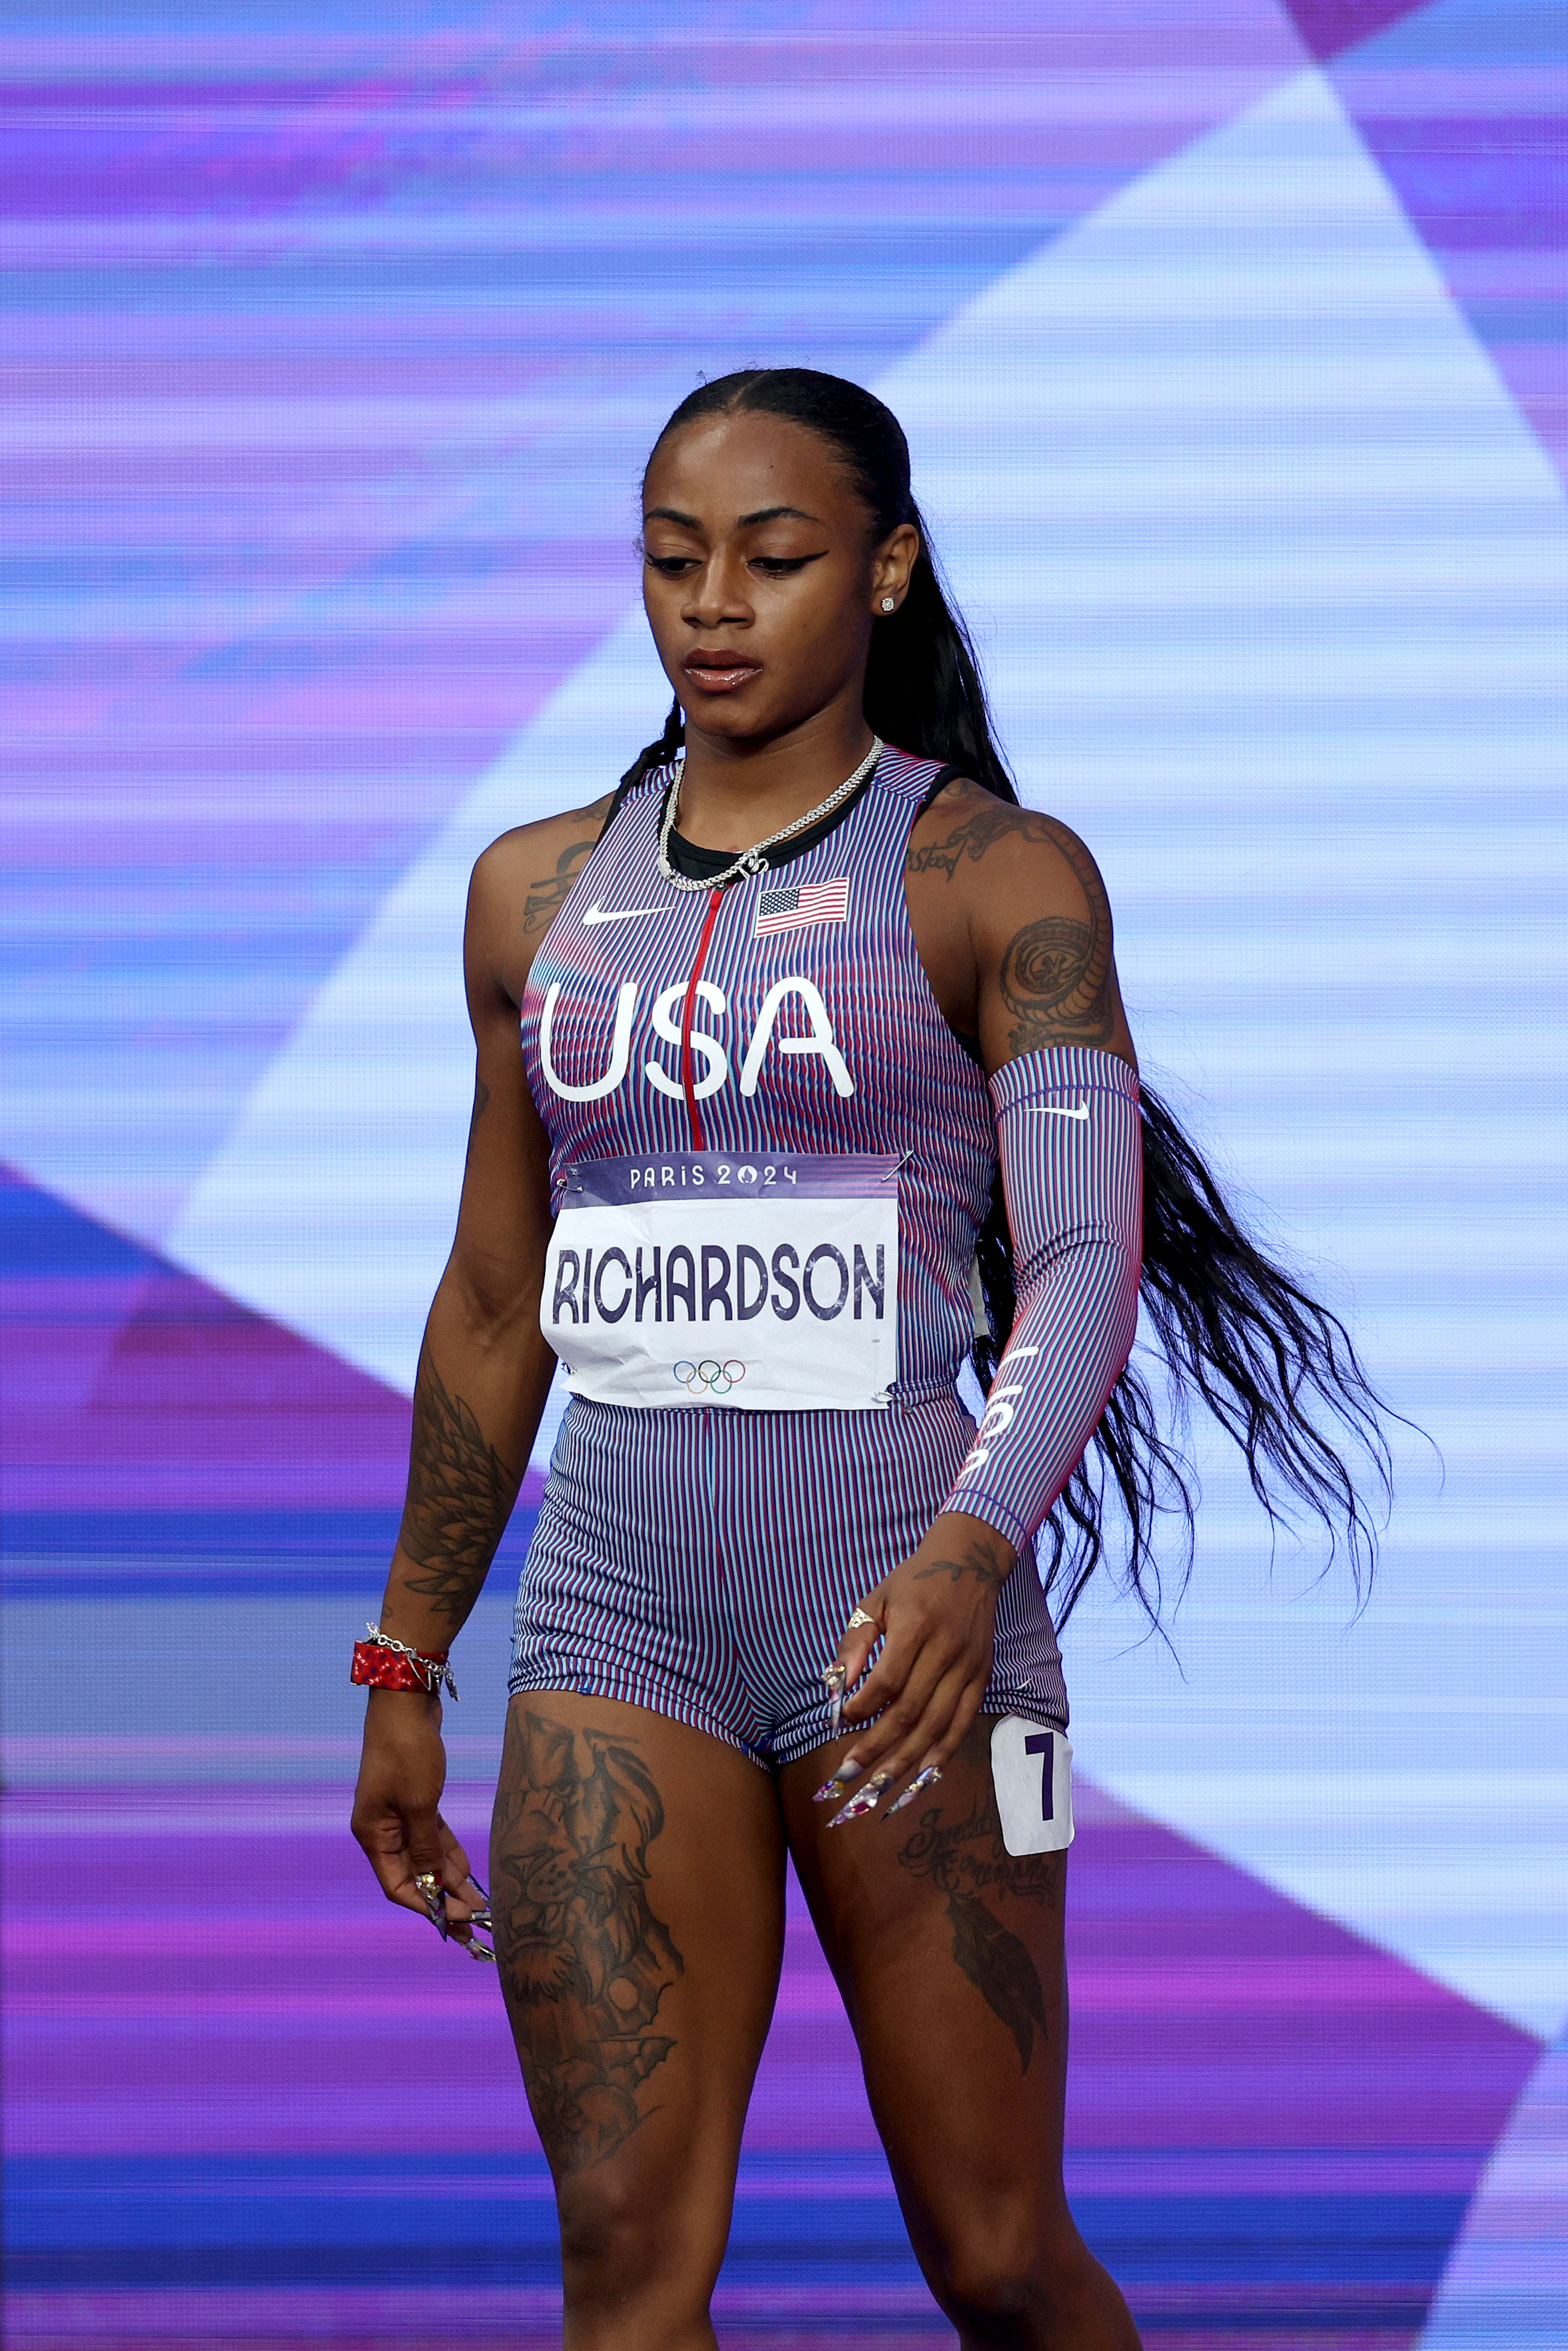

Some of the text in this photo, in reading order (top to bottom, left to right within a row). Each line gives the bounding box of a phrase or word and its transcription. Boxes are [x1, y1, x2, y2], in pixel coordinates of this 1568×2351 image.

[540, 976, 855, 1103] USA
[552, 1243, 885, 1324] RICHARDSON
[1024, 1731, 1054, 1821] 7
